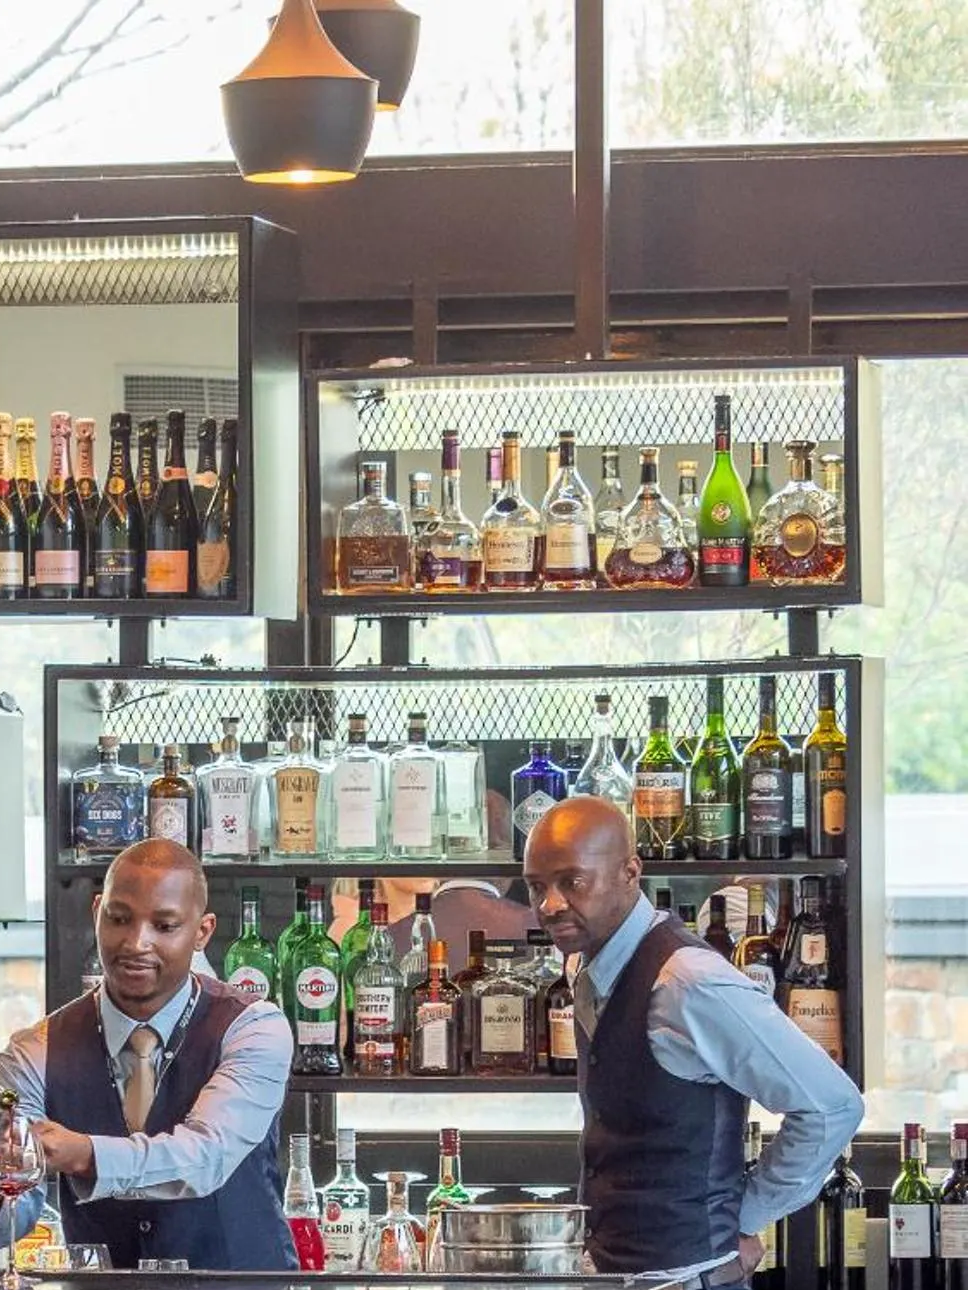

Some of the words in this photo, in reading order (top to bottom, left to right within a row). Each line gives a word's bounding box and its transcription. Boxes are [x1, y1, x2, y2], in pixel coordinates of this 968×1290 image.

[88, 810, 102, 820] SIX
[103, 810, 123, 820] DOGS
[297, 983, 336, 993] MARTINI
[320, 1224, 353, 1233] CARDI
